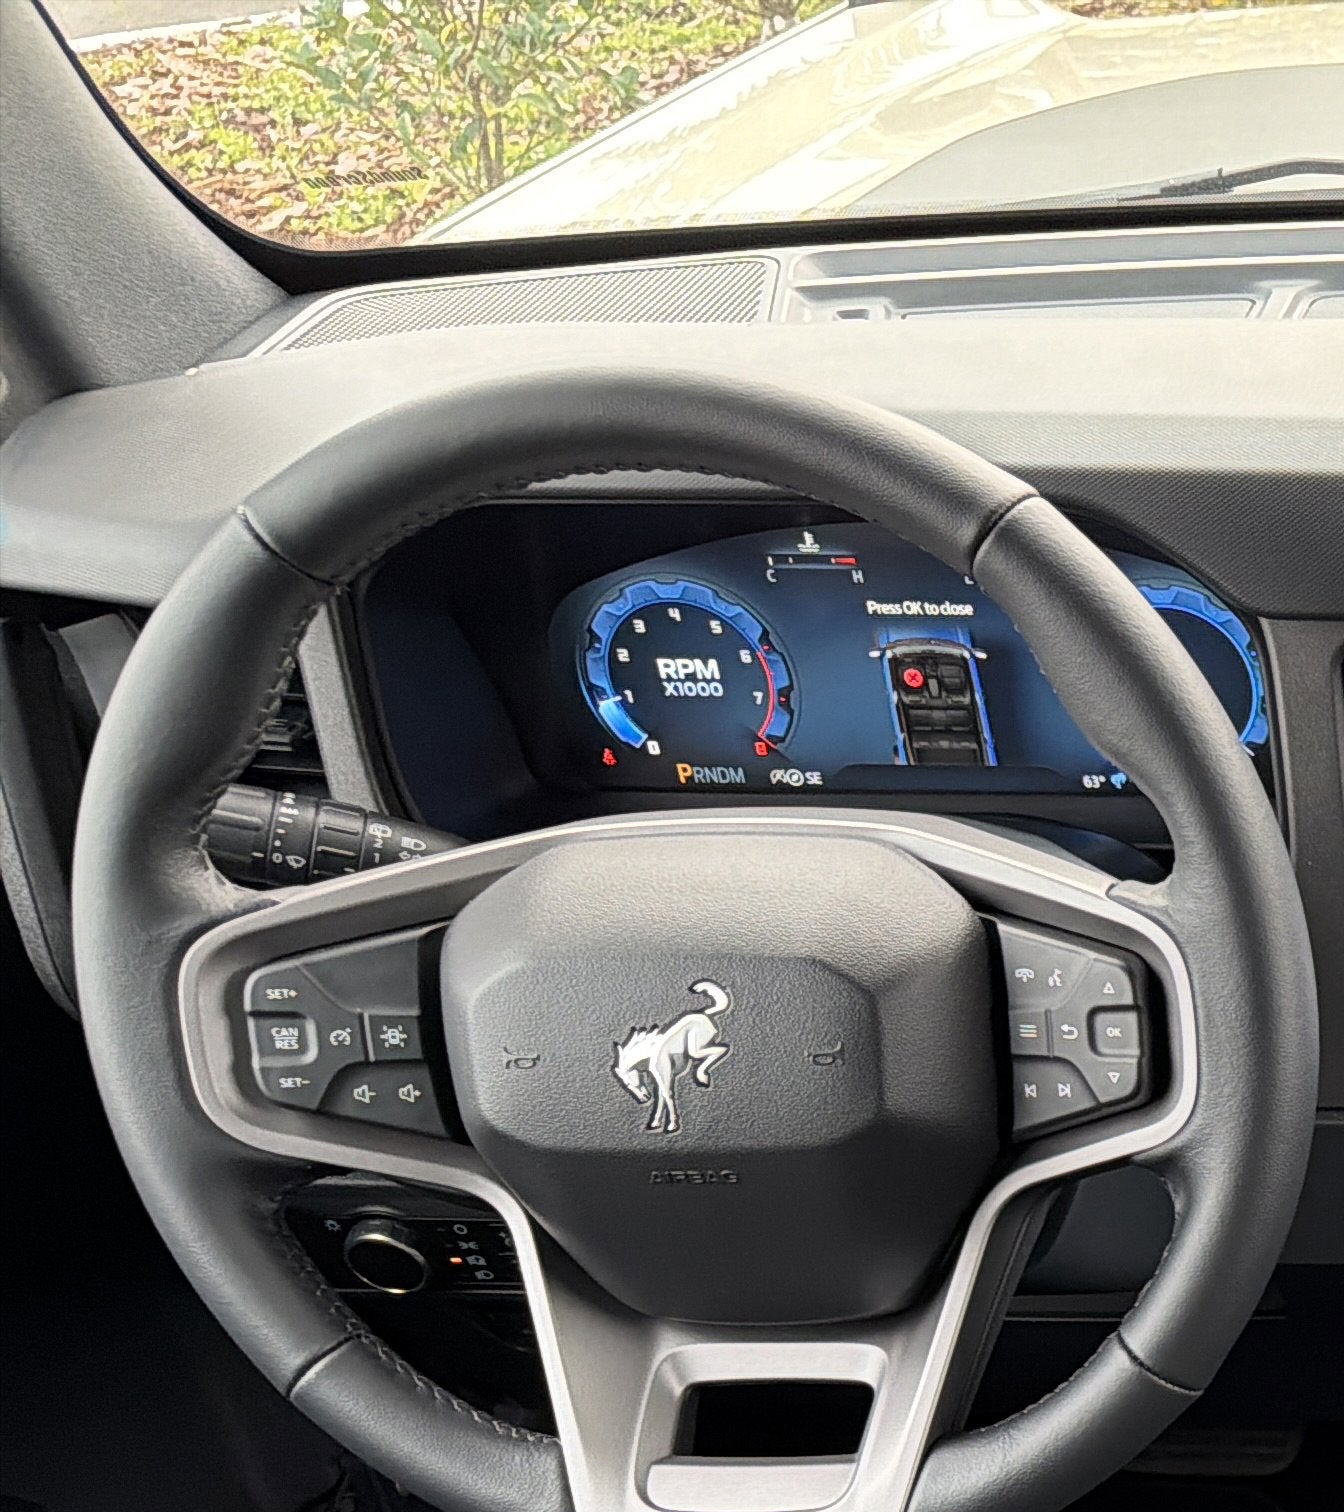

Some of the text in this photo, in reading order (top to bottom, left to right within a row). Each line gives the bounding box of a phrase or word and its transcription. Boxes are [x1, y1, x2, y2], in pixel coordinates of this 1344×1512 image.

[766, 568, 777, 583] C
[851, 569, 864, 584] H
[667, 607, 682, 622] 4
[866, 600, 974, 616] Press OK to close
[632, 618, 647, 634] 3
[709, 620, 723, 635] 5
[615, 648, 630, 662] 2
[738, 649, 752, 664] 6
[656, 657, 721, 680] RPM
[623, 689, 634, 704] 1
[662, 681, 724, 697] X1000
[752, 690, 764, 705] 7
[646, 740, 661, 756] 0
[265, 988, 299, 1000] SET+
[270, 1026, 299, 1038] CAN
[1105, 1026, 1122, 1038] OK
[274, 1040, 300, 1050] RES
[649, 1169, 738, 1184] AIRBAG
